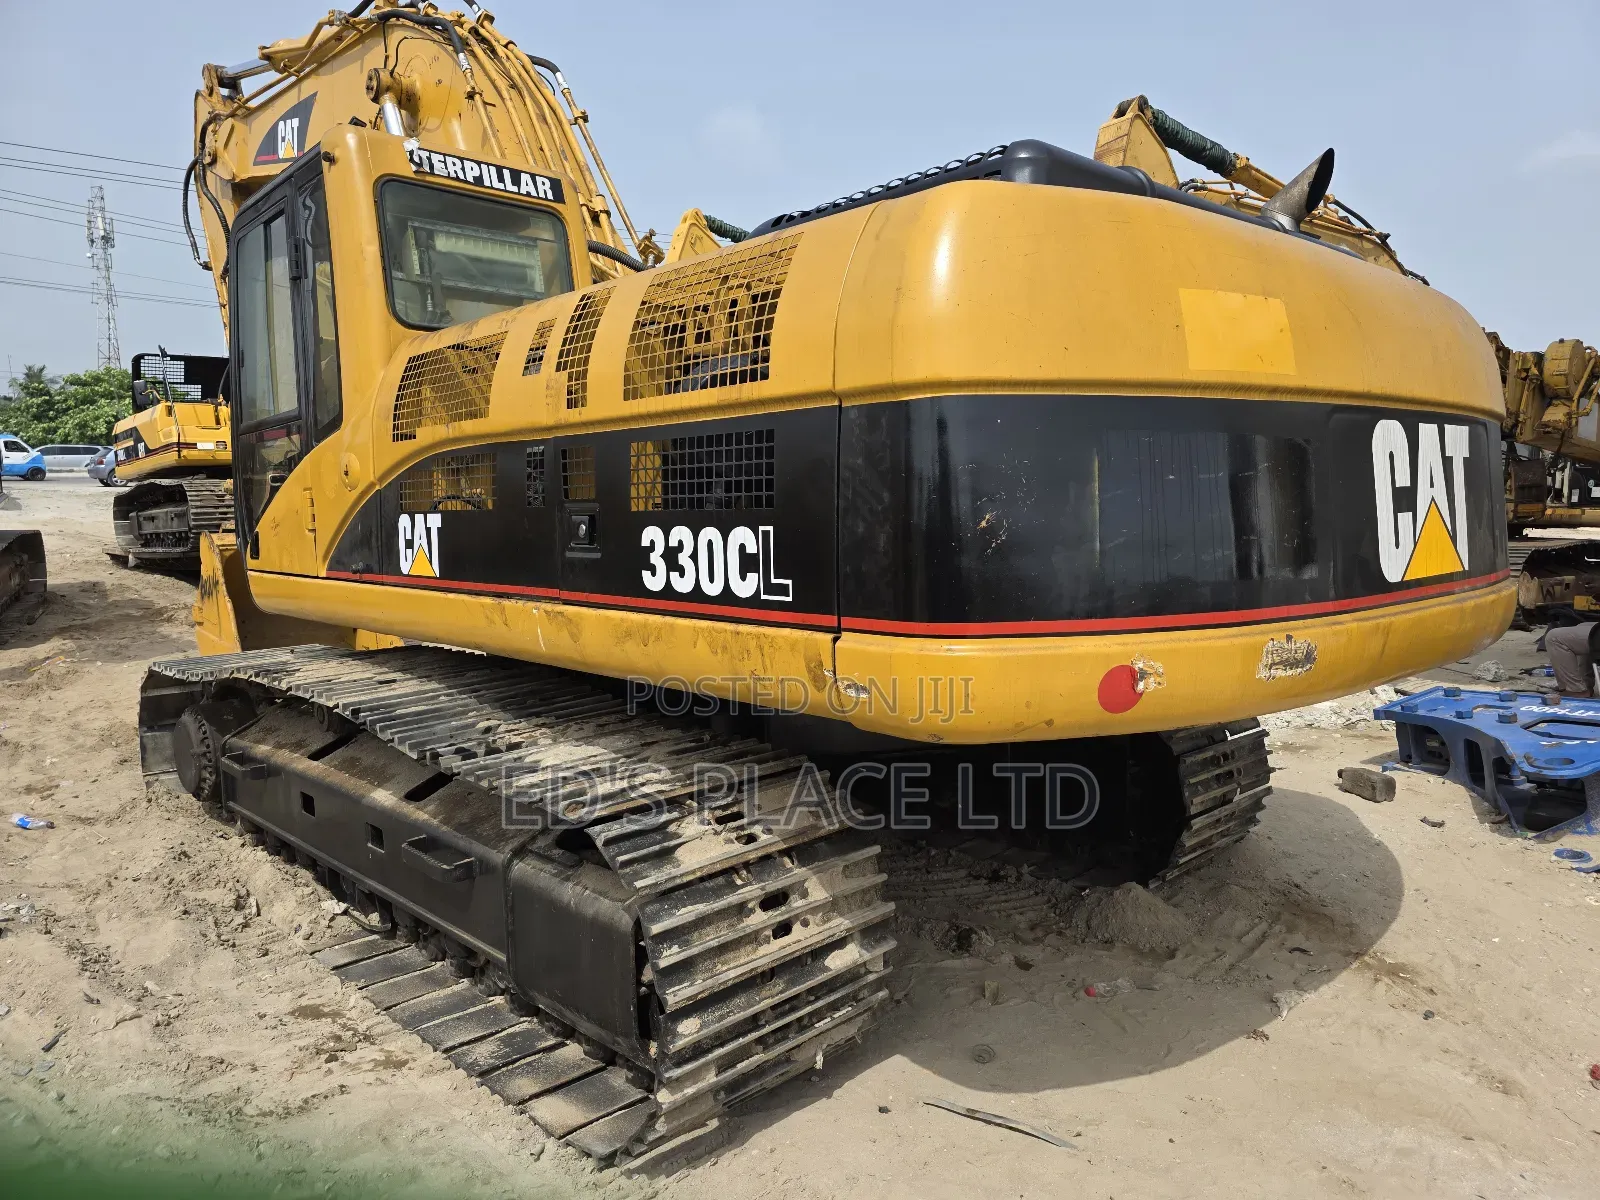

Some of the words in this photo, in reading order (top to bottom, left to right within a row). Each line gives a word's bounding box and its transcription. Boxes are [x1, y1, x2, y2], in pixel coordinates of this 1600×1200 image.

[278, 117, 299, 159] CAT
[404, 139, 554, 200] TERPILLAR
[1372, 419, 1469, 583] CAT
[398, 513, 442, 578] CAT
[641, 525, 793, 602] 330CL
